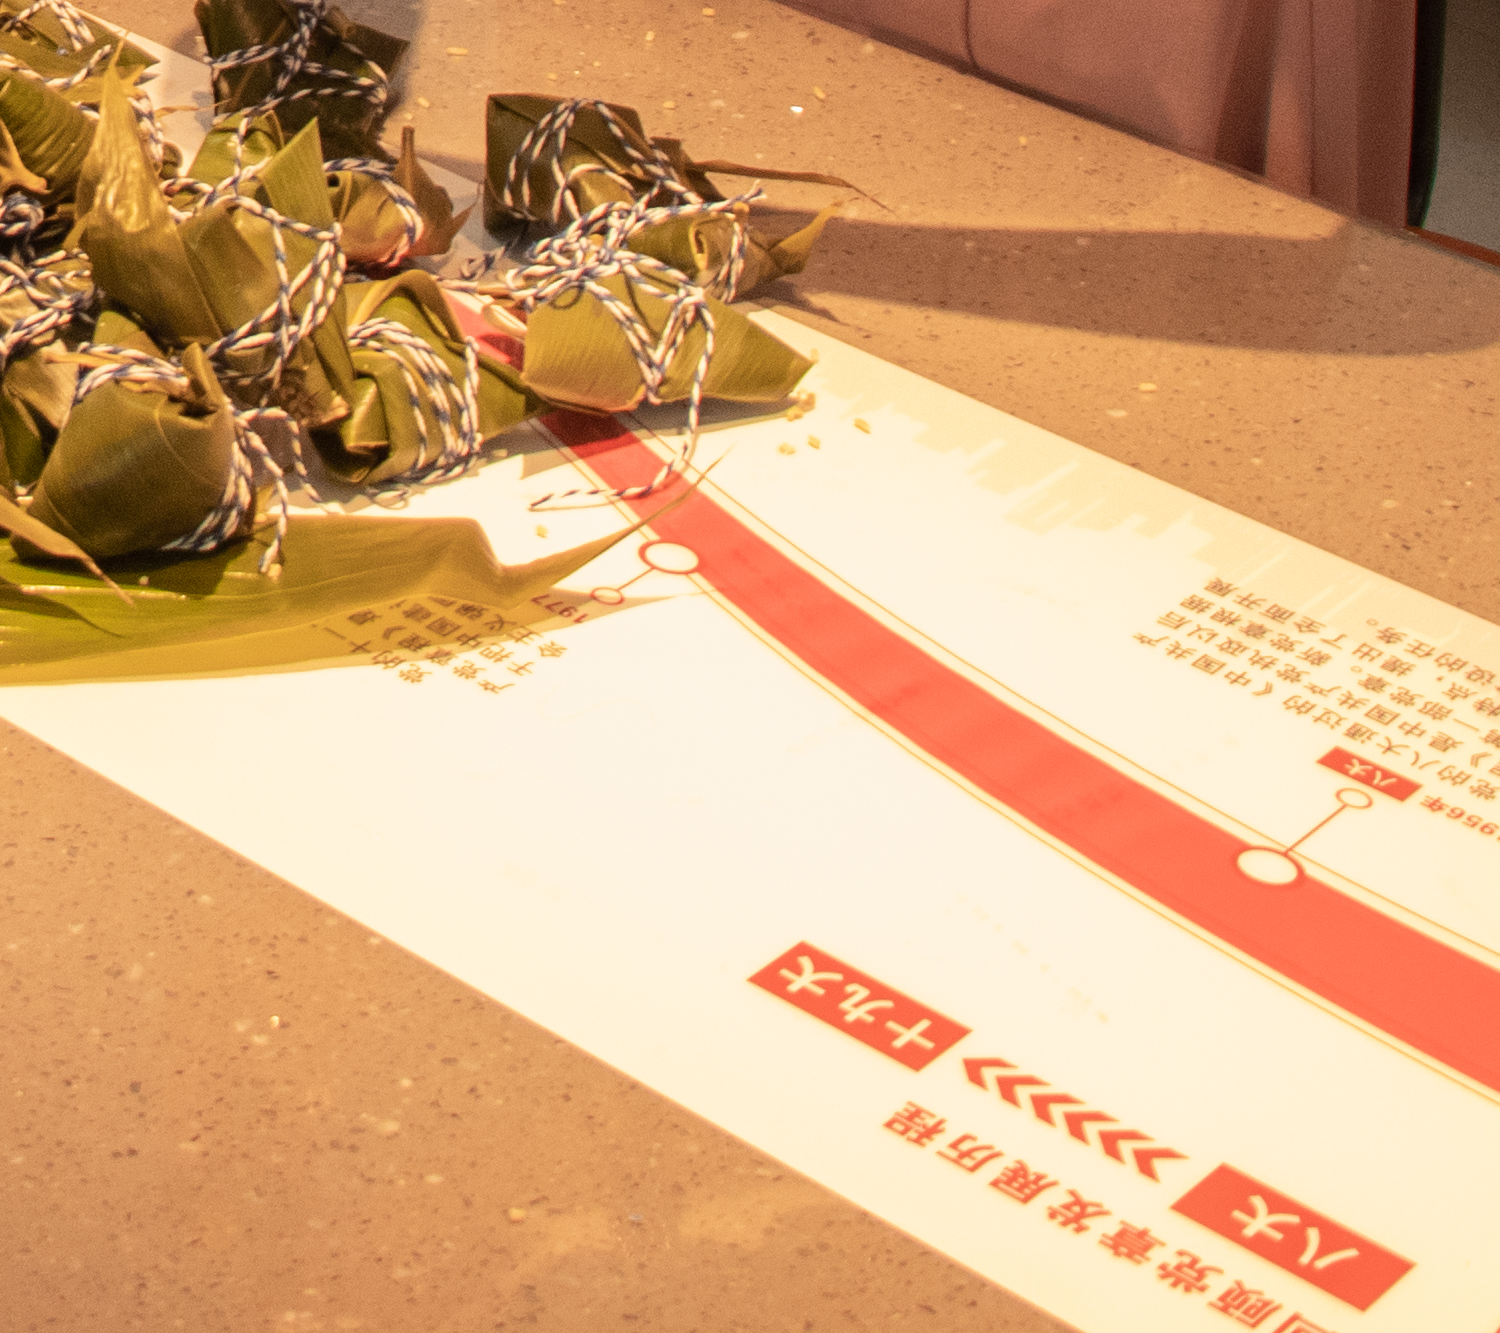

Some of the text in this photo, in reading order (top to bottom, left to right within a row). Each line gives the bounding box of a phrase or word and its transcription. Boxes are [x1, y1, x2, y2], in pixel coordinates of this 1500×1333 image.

[387, 598, 535, 677] 于把中国建
[529, 593, 589, 624] 1977
[313, 623, 434, 684] 党的十一
[1343, 757, 1397, 787] 八大
[778, 954, 1361, 1271] 八大 十九大
